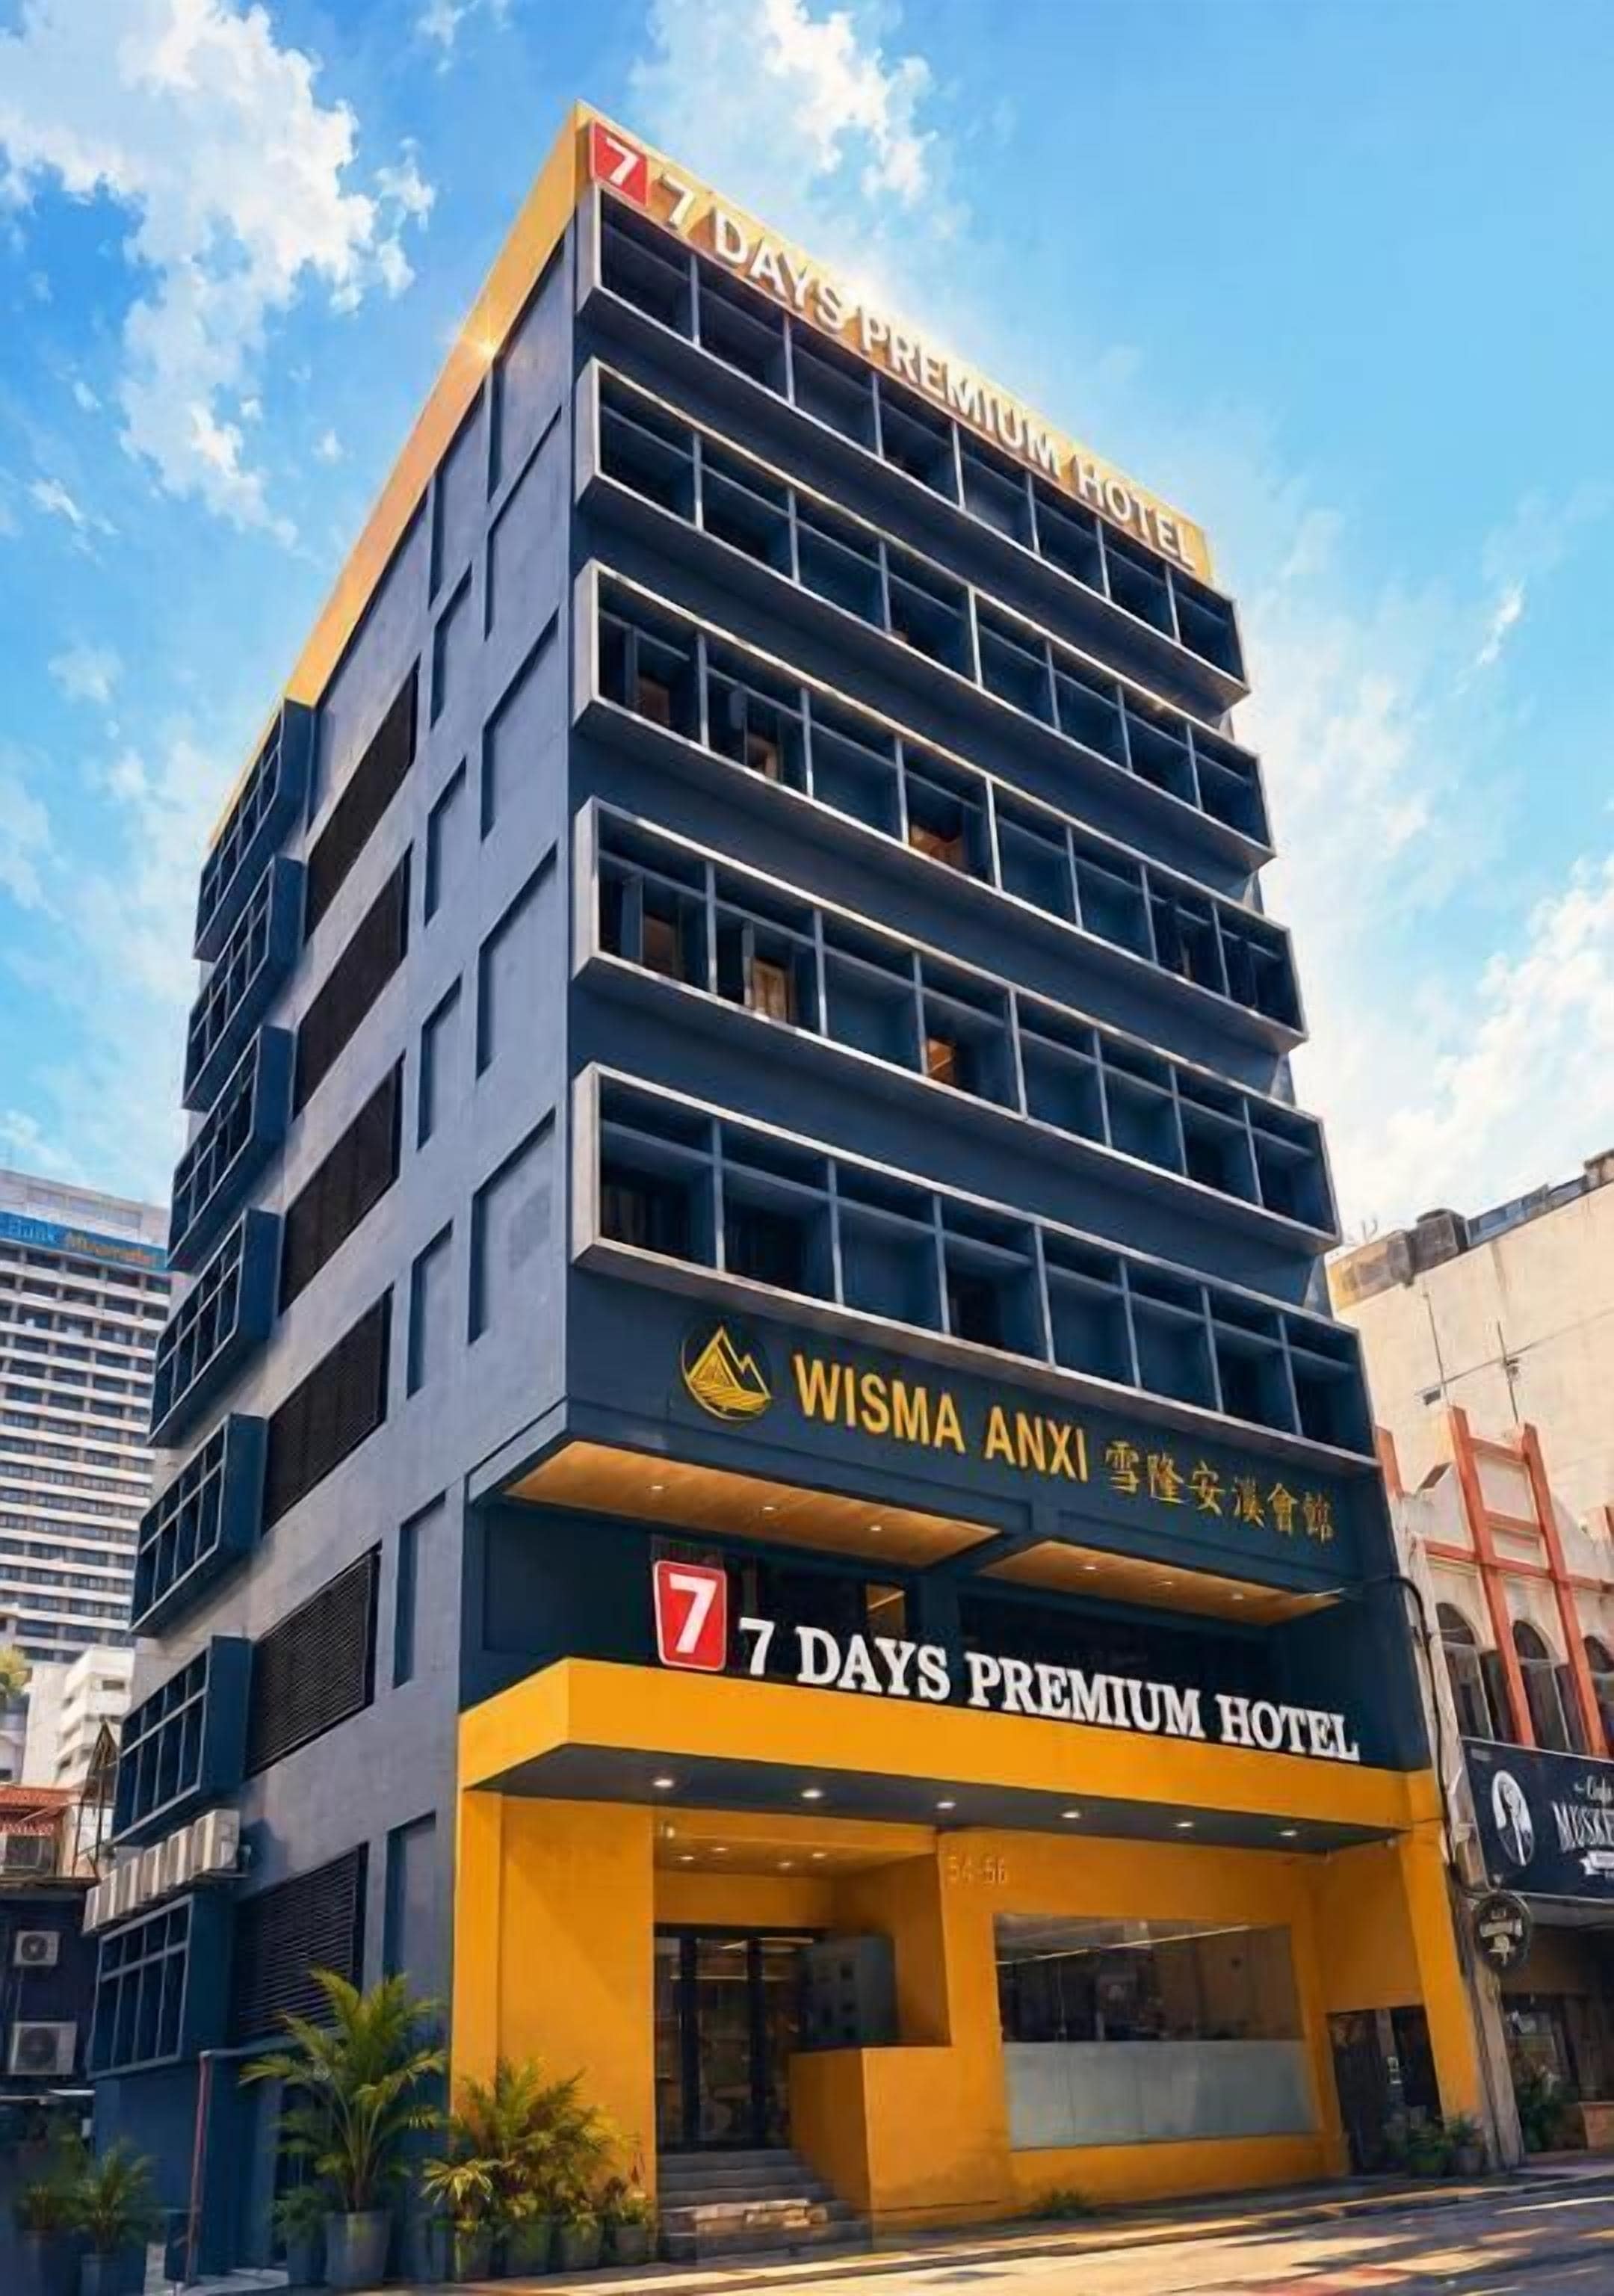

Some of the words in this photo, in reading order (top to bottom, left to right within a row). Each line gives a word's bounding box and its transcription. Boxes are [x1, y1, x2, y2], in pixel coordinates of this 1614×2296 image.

[605, 136, 641, 187] 7
[661, 172, 698, 227] 7
[714, 207, 846, 336] DAYS
[859, 306, 1061, 476] PREMIUM
[1072, 453, 1197, 572] HOTEL
[793, 1353, 967, 1454] WISMA
[984, 1405, 1089, 1483] ANXI
[668, 1572, 718, 1655] 7
[739, 1616, 776, 1676] 7
[794, 1625, 951, 1702] DAYS
[964, 1650, 1208, 1740] PREMIUM
[1214, 1693, 1361, 1762] HOTEL
